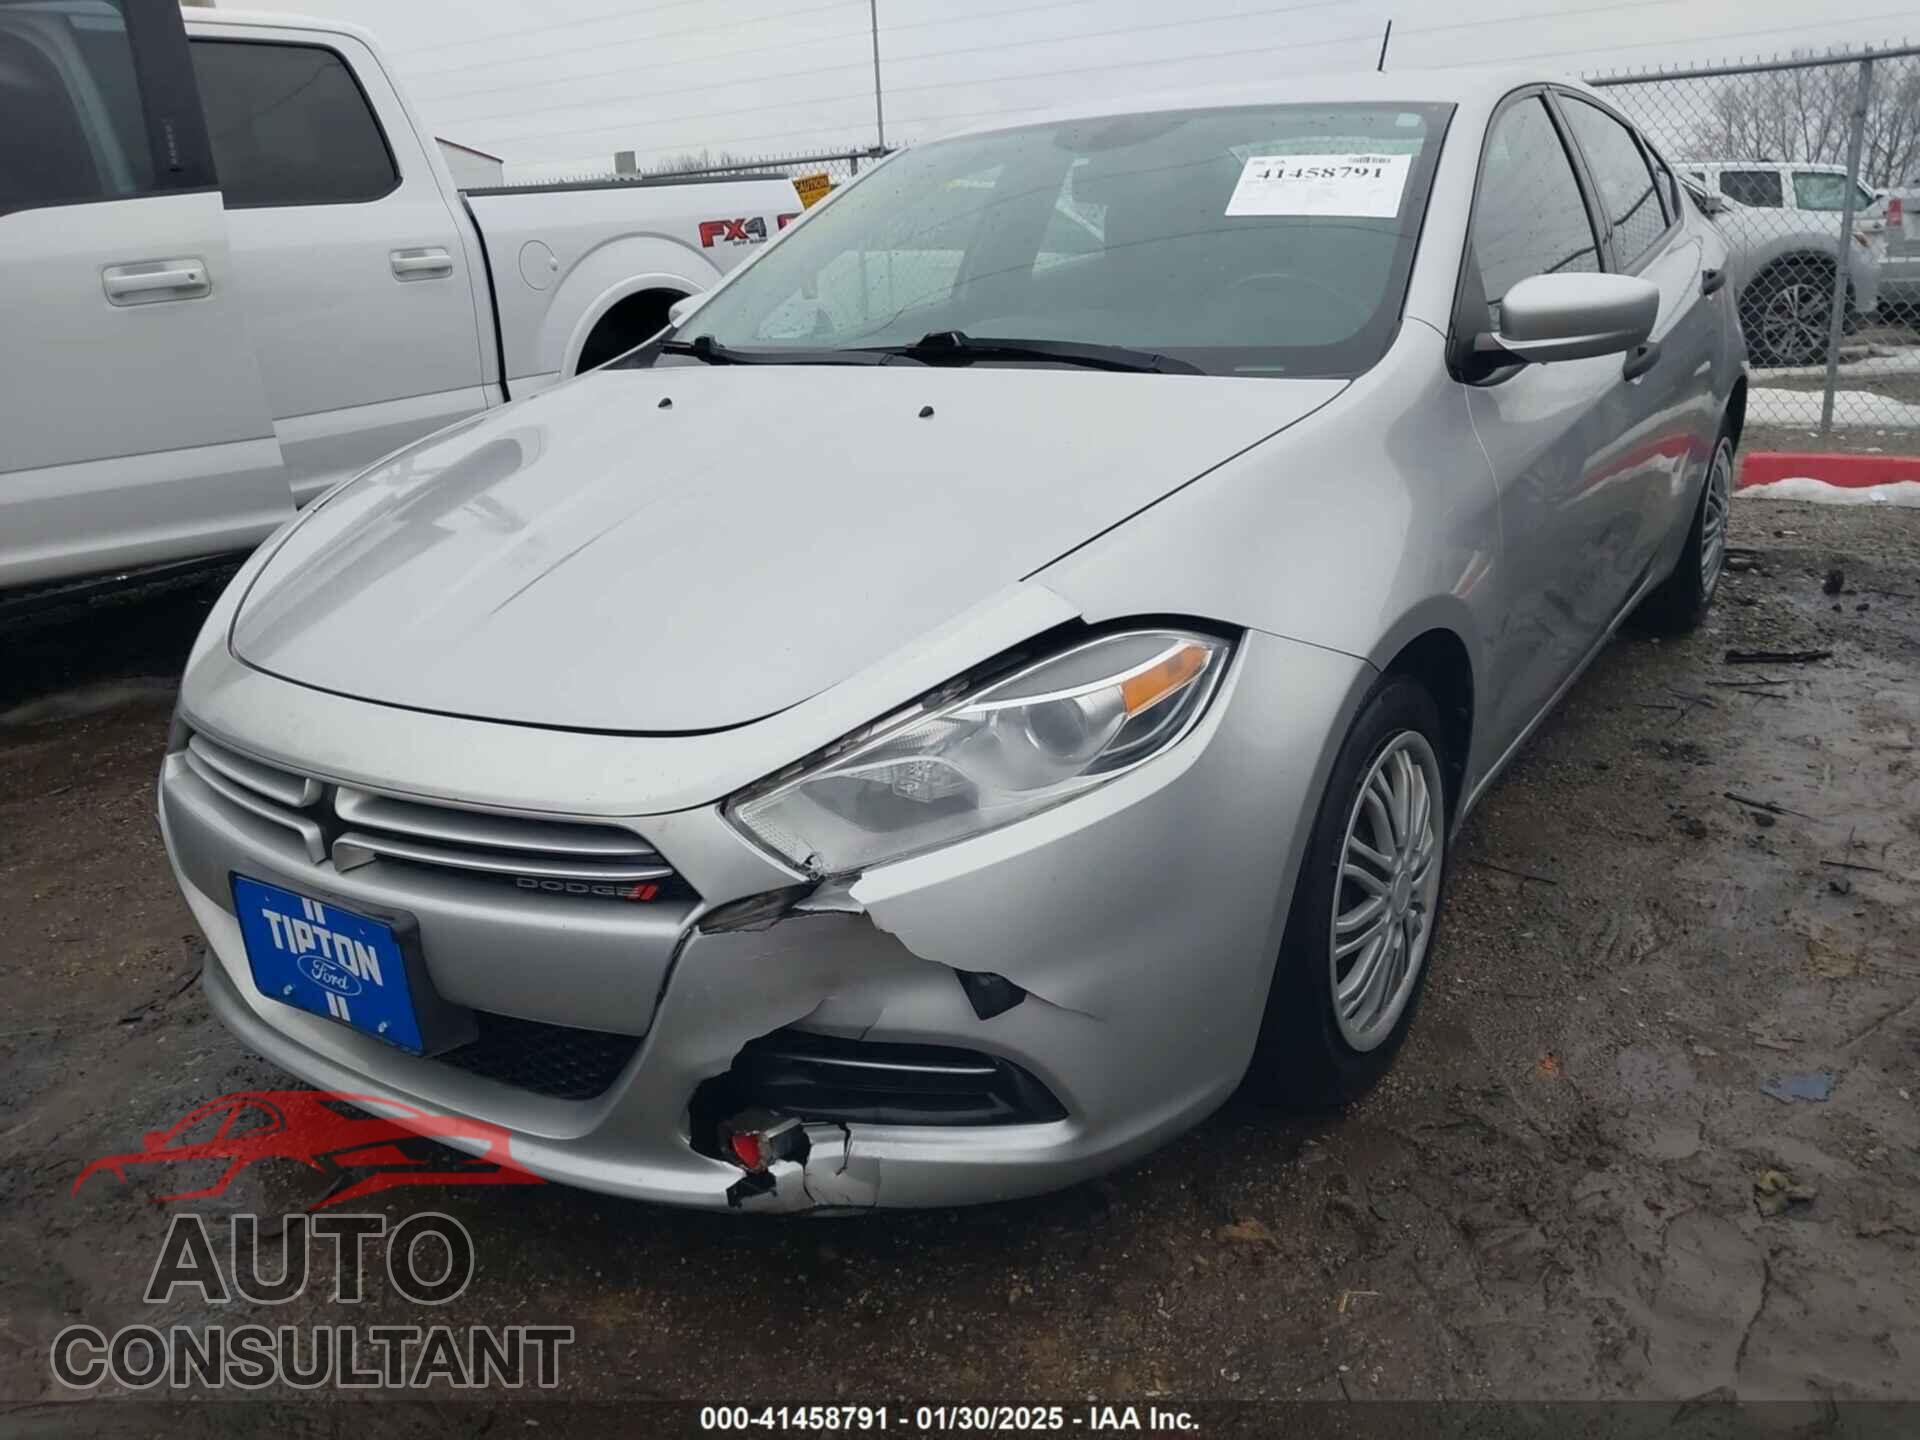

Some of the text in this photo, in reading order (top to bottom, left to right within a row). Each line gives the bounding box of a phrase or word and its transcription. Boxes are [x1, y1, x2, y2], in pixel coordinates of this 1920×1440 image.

[1256, 166, 1383, 179] 41458791
[699, 217, 767, 248] FX4
[516, 877, 640, 899] DODGE
[262, 909, 384, 987] TIPTON
[311, 959, 349, 990] Ford
